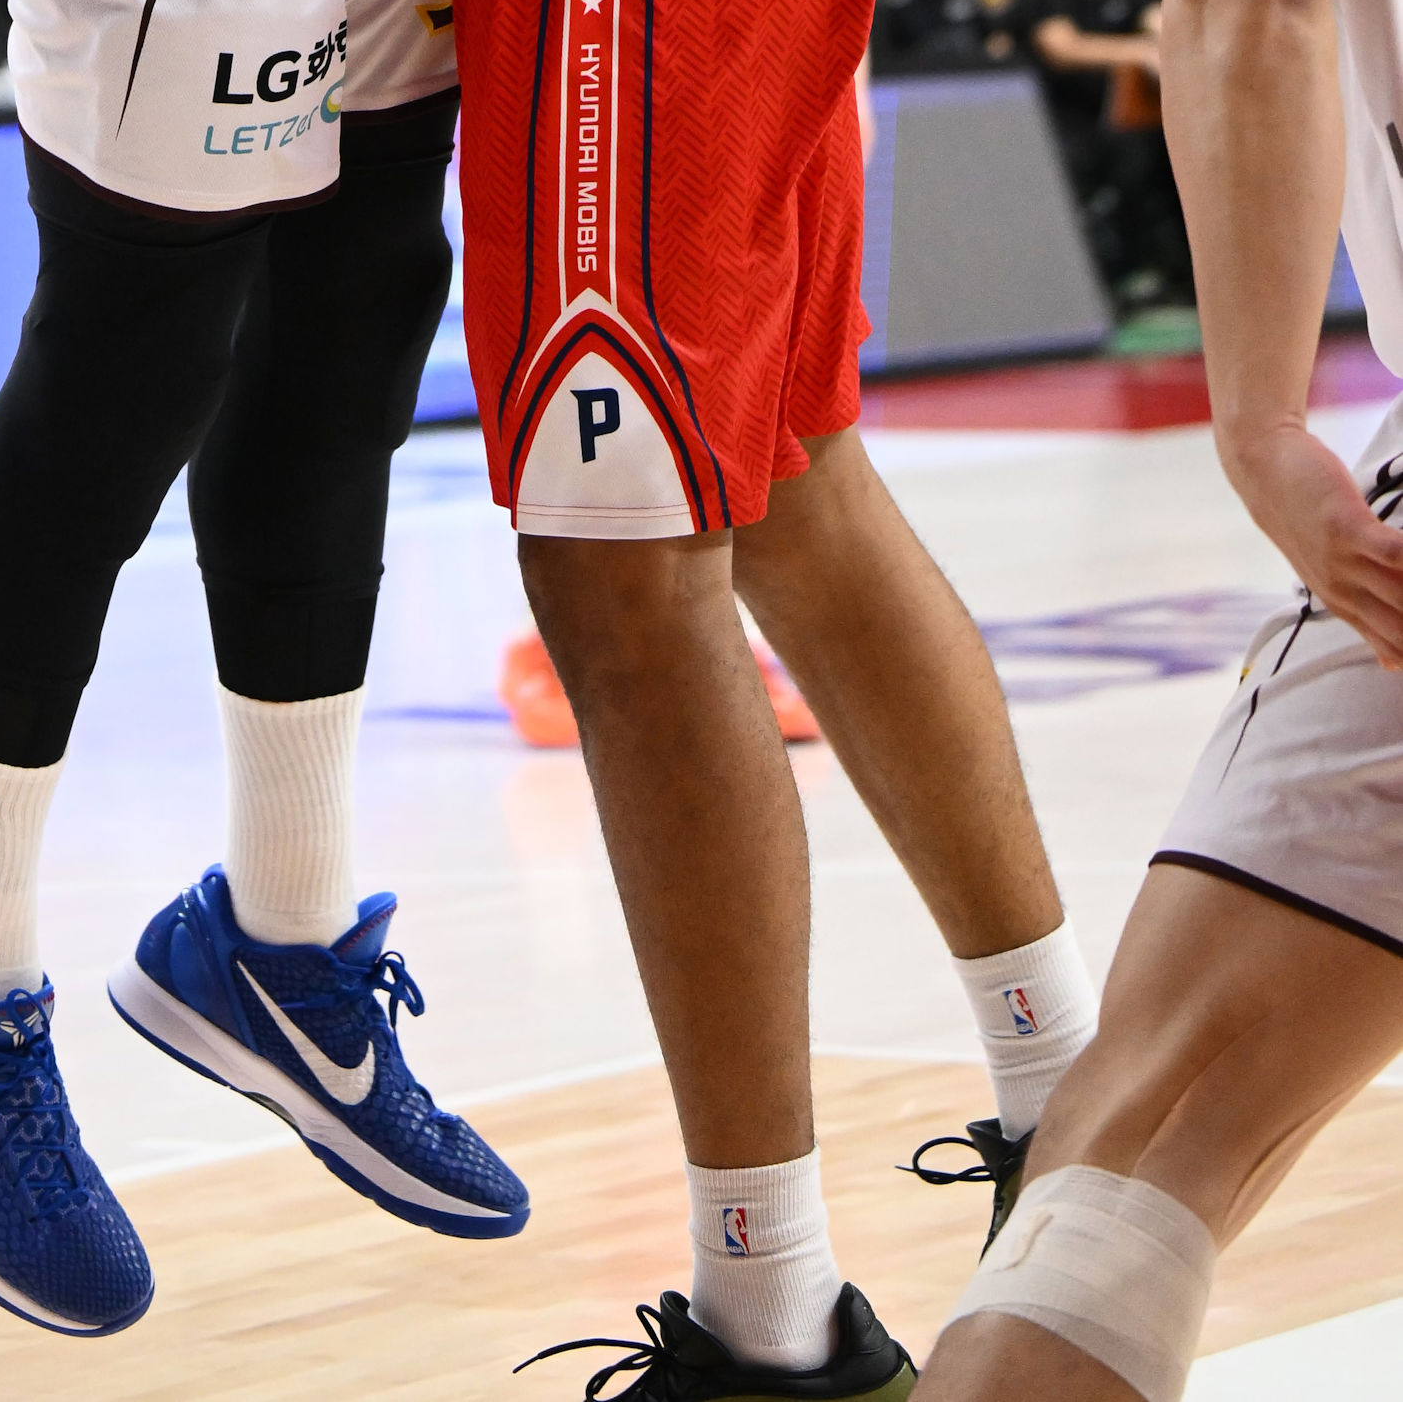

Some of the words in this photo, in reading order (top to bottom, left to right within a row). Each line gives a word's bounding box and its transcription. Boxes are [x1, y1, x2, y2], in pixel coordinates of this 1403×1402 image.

[578, 43, 601, 173] HYUNDAI
[575, 180, 599, 273] MOBIS
[570, 387, 620, 464] P
[727, 1245, 745, 1254] NBA
